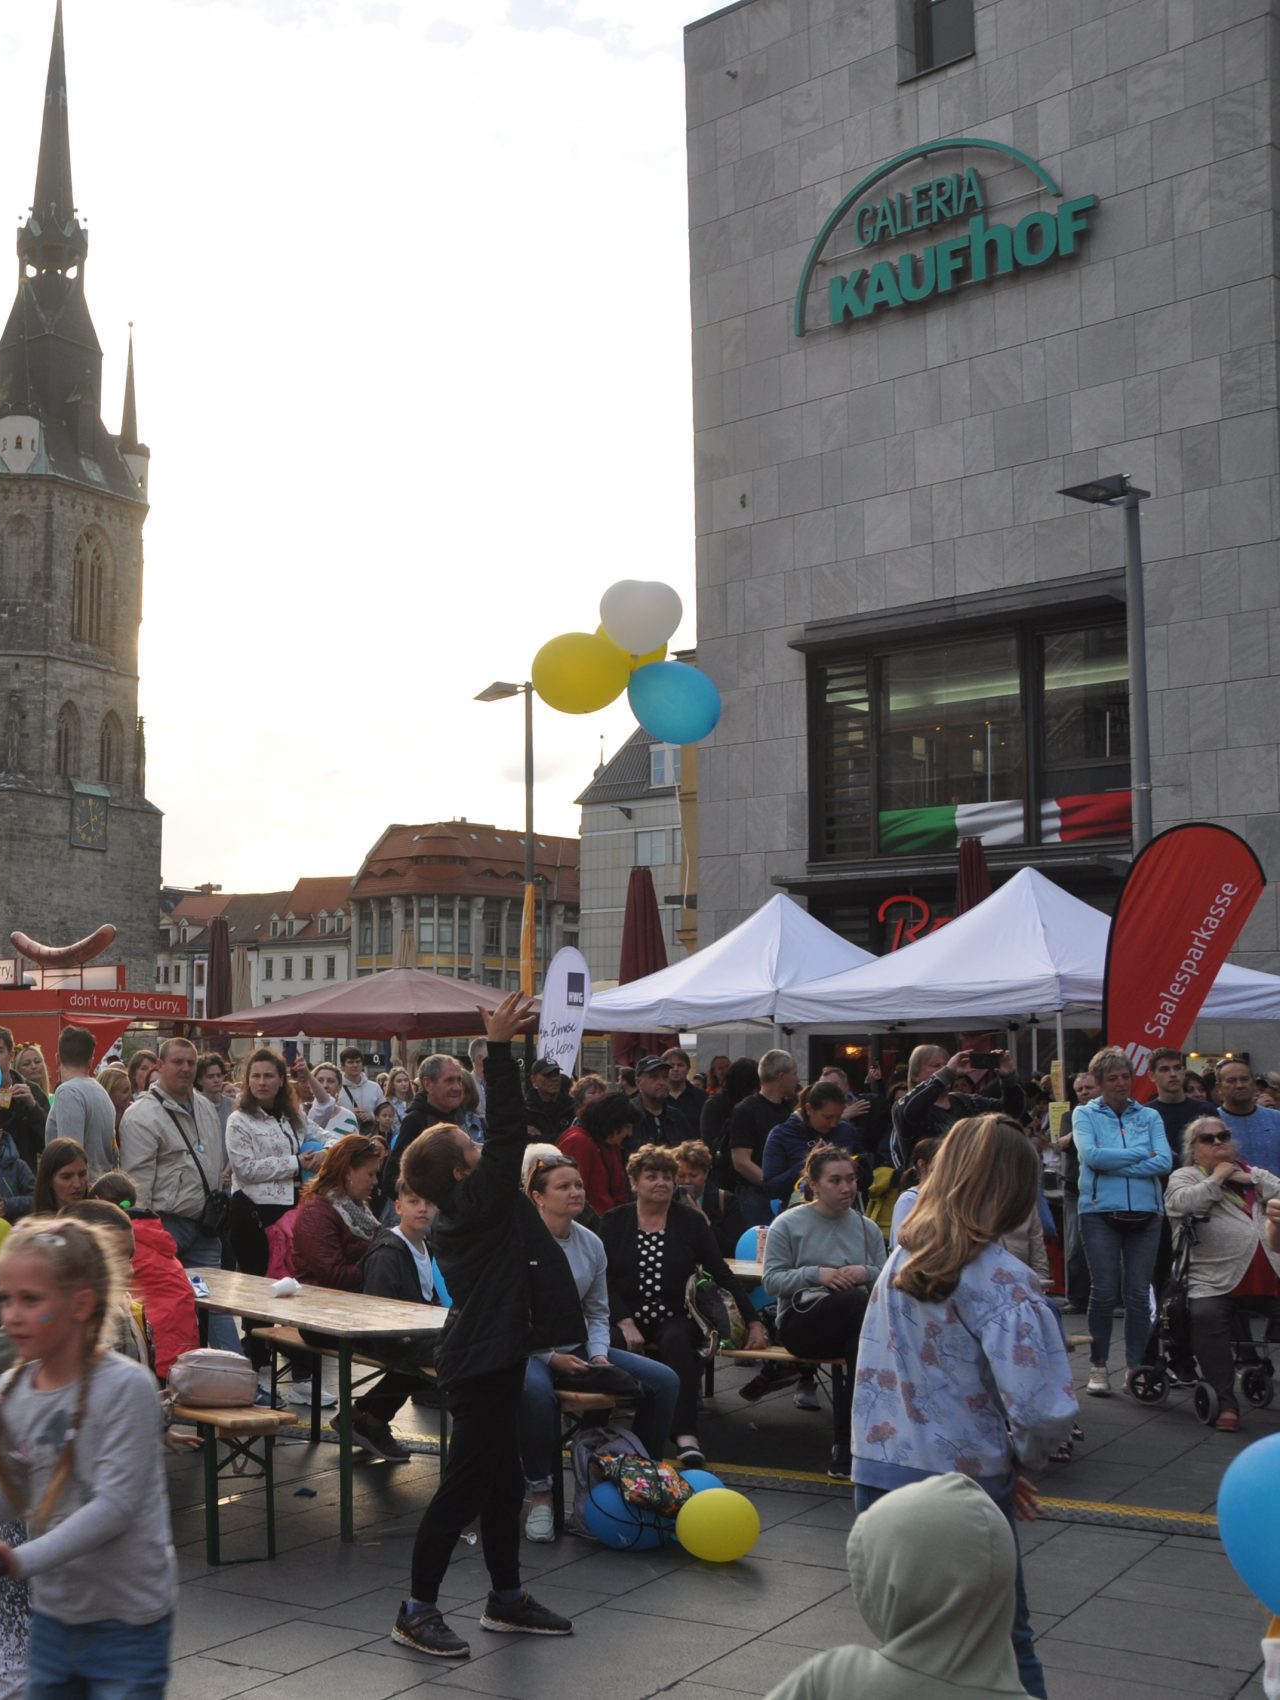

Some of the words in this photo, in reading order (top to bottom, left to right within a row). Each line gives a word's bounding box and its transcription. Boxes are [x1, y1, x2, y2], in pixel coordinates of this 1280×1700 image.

[852, 166, 985, 247] GALERIA
[1144, 882, 1239, 1038] Saalesparkasse
[100, 999, 130, 1011] worry
[133, 996, 146, 1009] be
